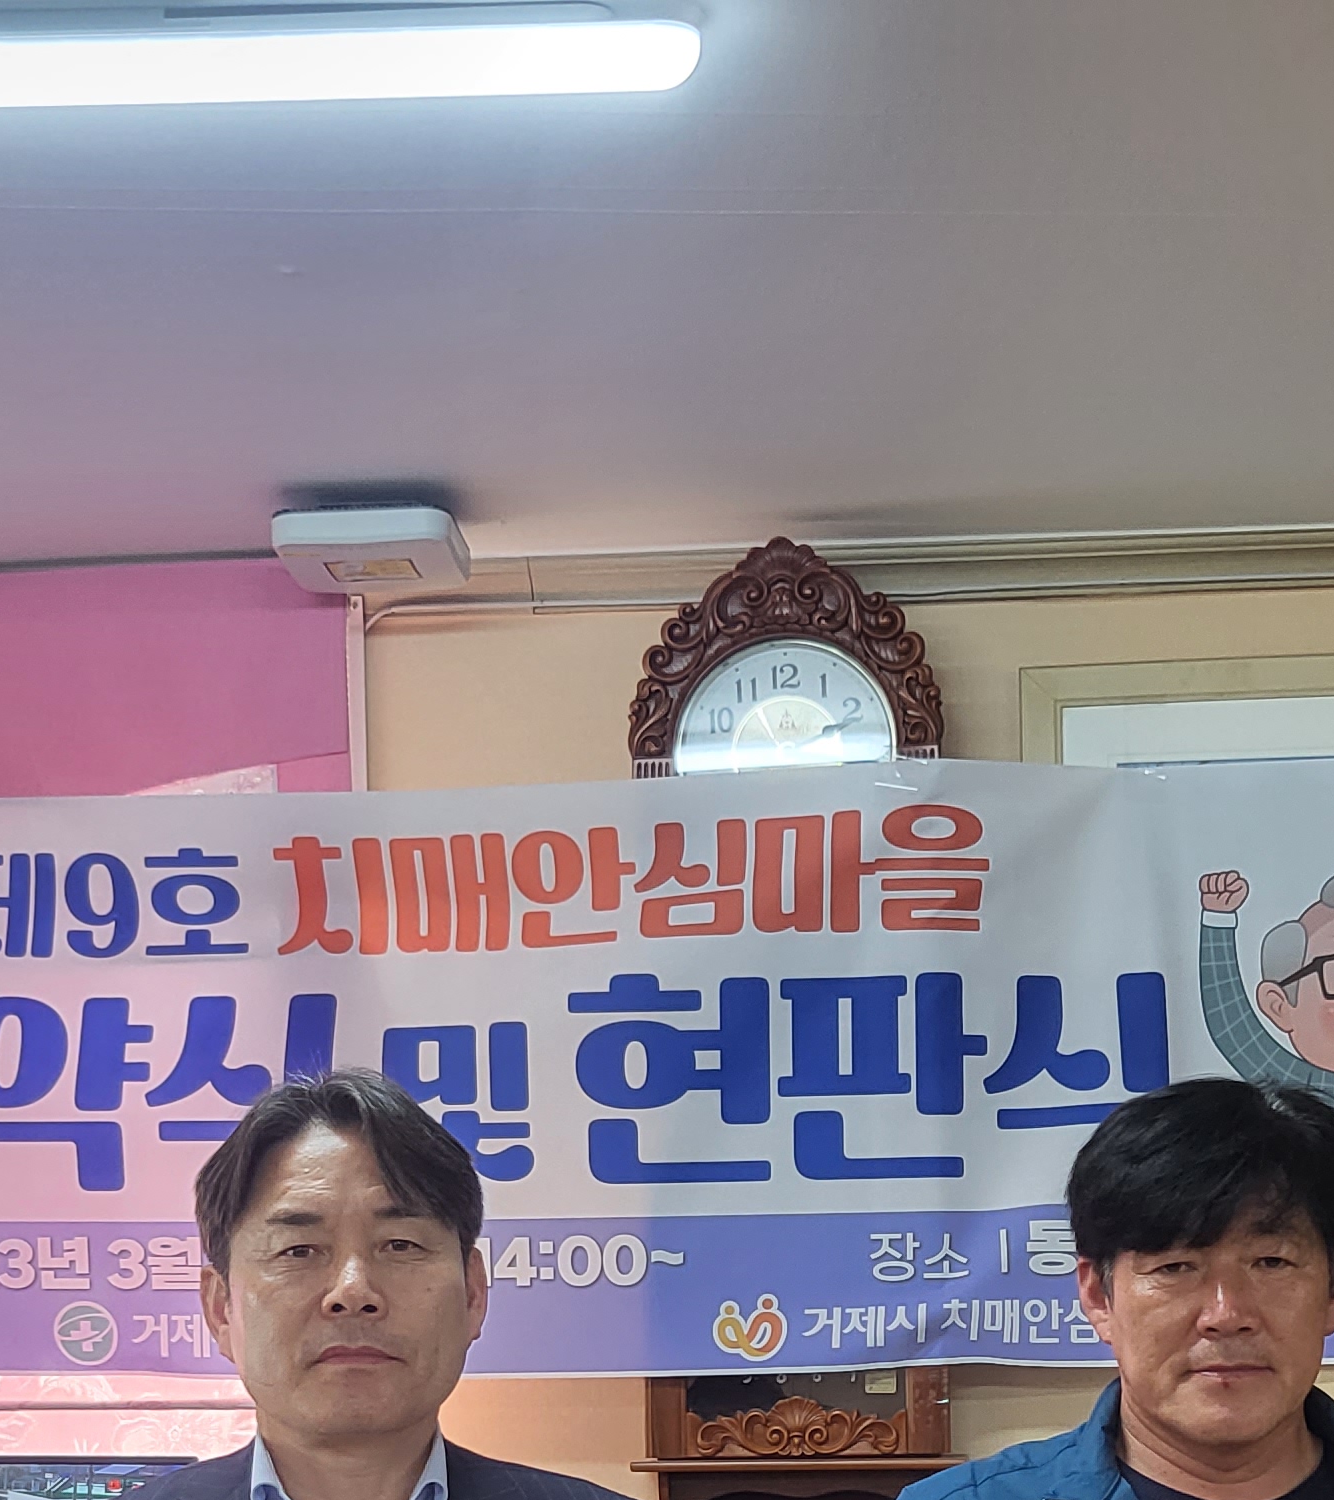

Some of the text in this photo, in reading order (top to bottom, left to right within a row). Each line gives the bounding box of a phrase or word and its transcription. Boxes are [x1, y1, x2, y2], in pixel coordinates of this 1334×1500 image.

[735, 677, 758, 703] 11
[771, 664, 800, 690] 12
[709, 708, 735, 734] 10
[273, 804, 990, 955] 치매안심마을
[568, 972, 1170, 1184] 현판식
[107, 1236, 201, 1290] 3월
[870, 1232, 969, 1282] 장소
[802, 1302, 927, 1348] 거제시
